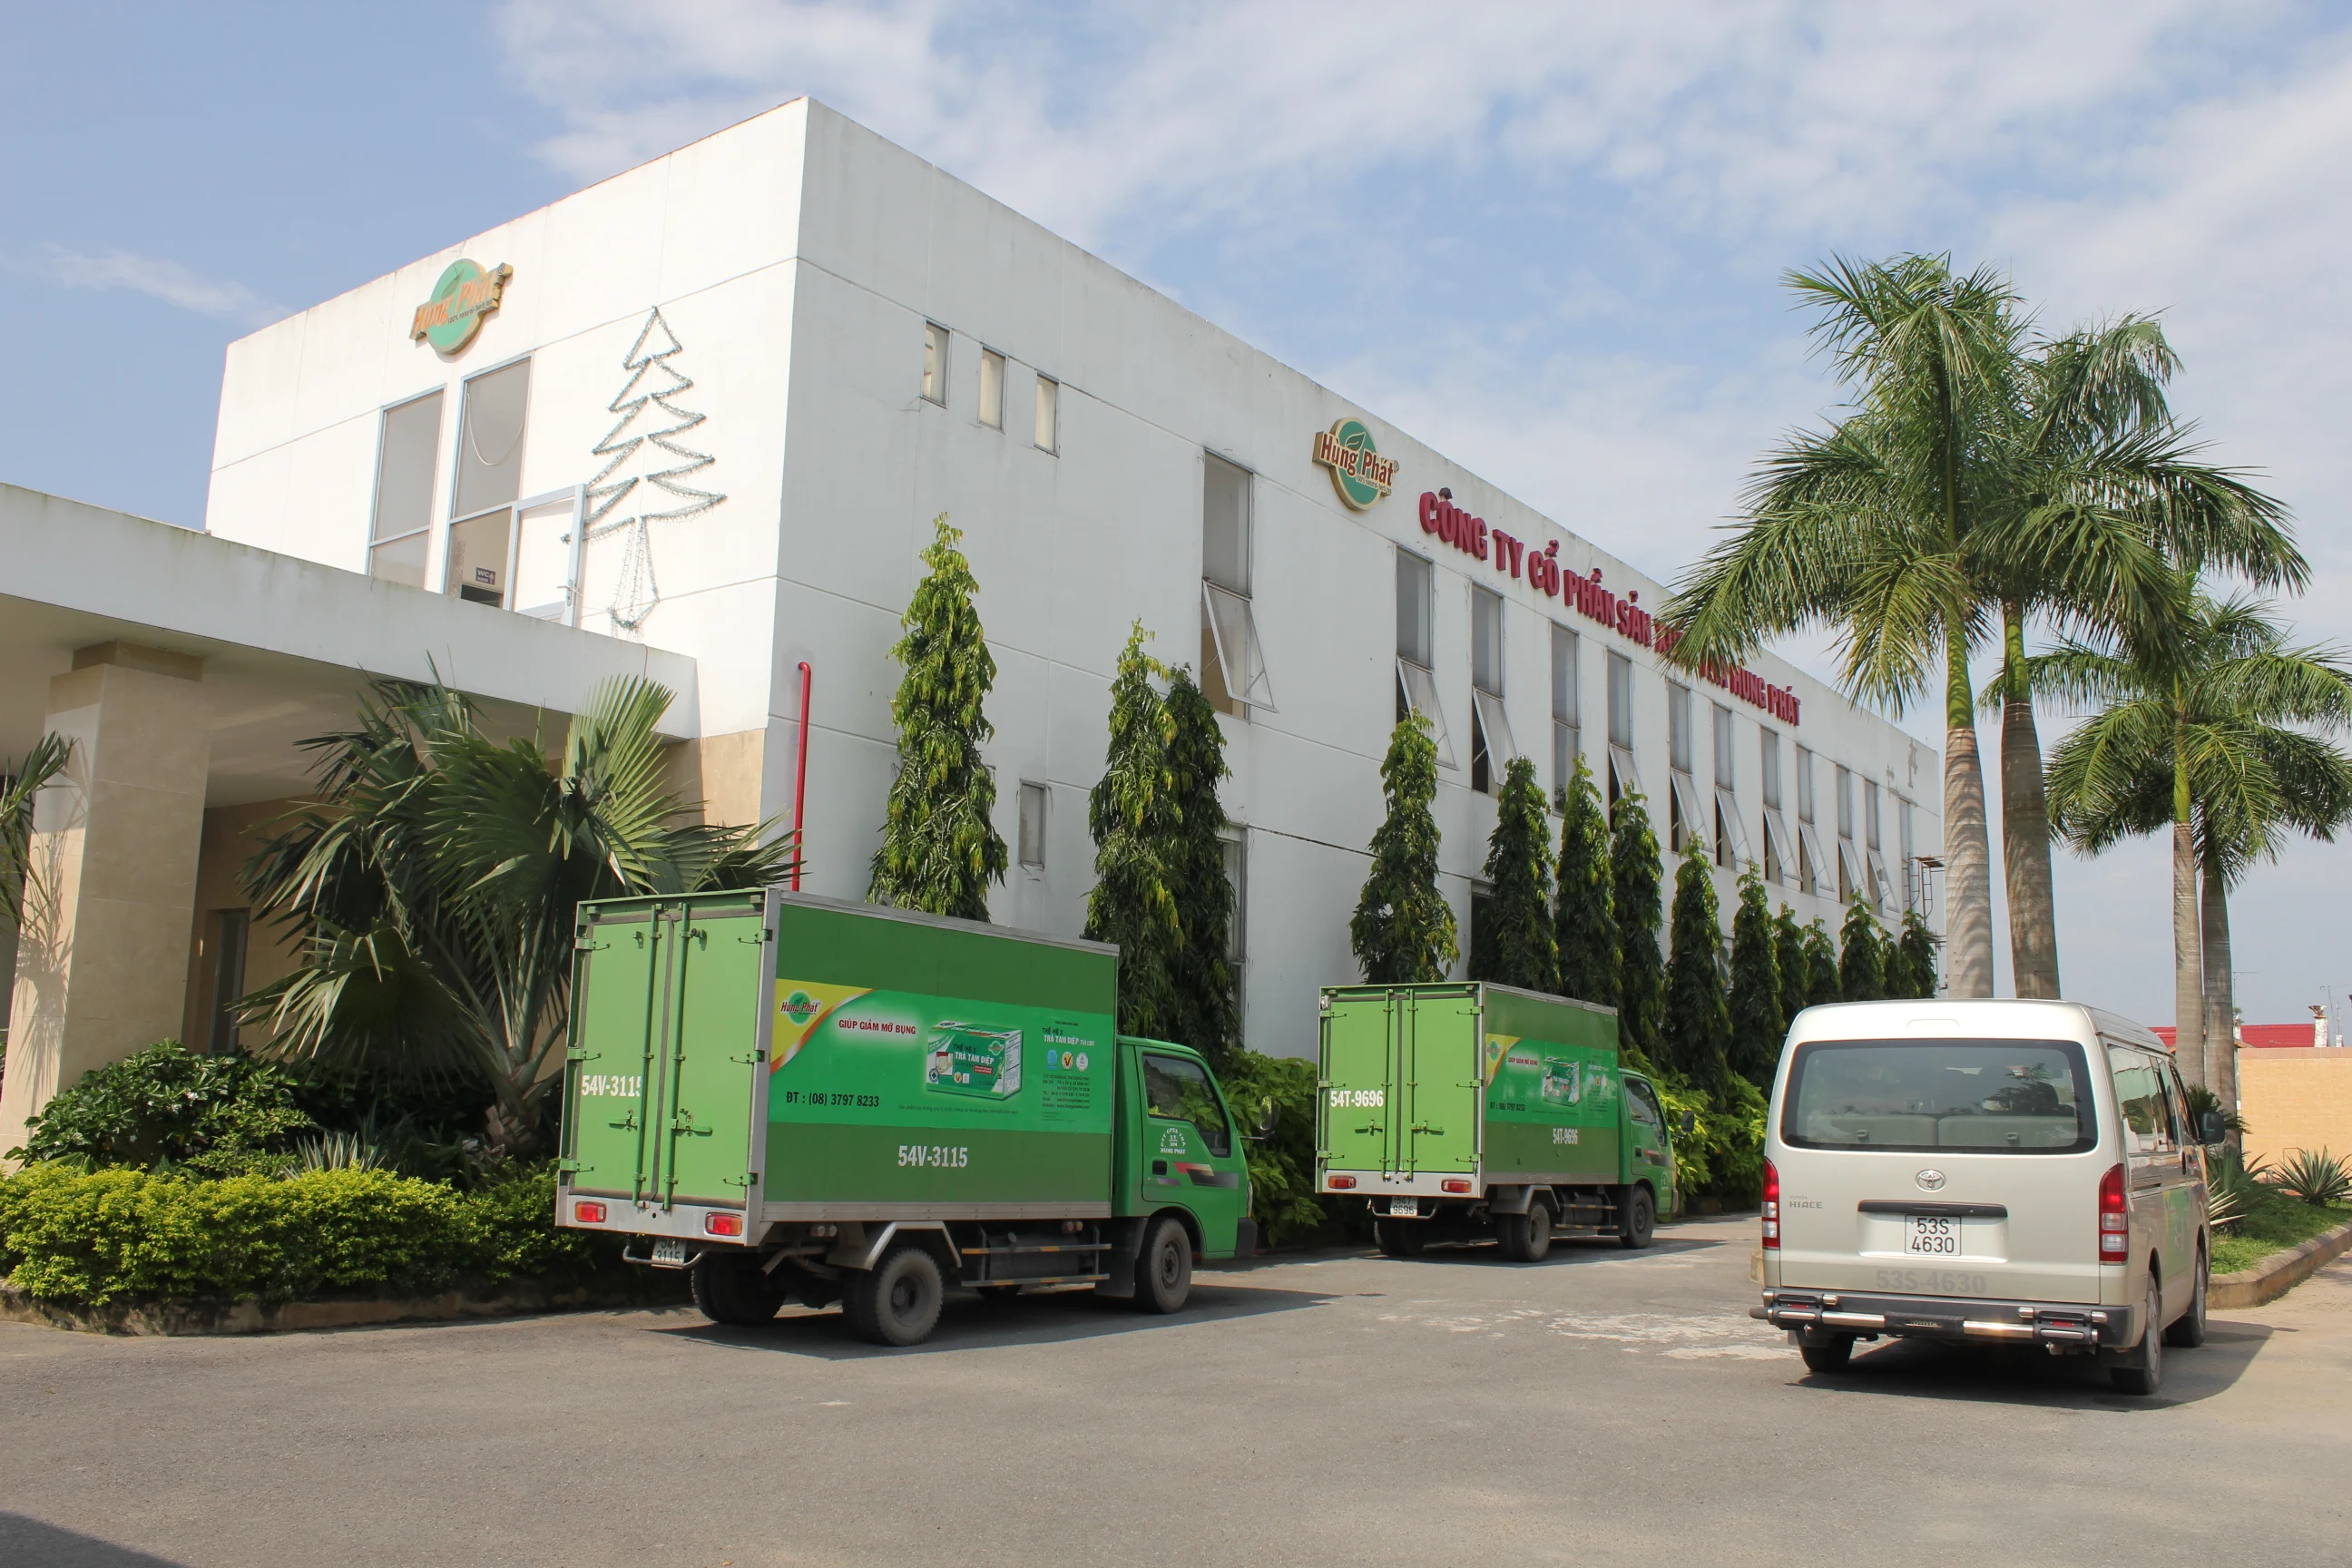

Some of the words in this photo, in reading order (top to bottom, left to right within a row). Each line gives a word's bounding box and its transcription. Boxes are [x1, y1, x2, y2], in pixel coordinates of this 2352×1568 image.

[1320, 434, 1358, 476] Hùng
[1362, 451, 1394, 486] Phát
[477, 569, 489, 578] WC
[1419, 487, 1487, 561] CÔNG
[1493, 529, 1524, 578] TY
[1528, 539, 1560, 597] CỔ
[1563, 568, 1615, 628] PHẦN
[1616, 591, 1651, 647] SẢN
[1767, 685, 1801, 727] PHÁT
[780, 1001, 799, 1014] Hùng
[801, 1001, 818, 1013] Phát
[838, 1018, 858, 1029] GIÚP
[859, 1019, 879, 1031] GIẢM
[895, 1024, 916, 1034] BỤNG
[1044, 1034, 1054, 1043] TRÀ
[1055, 1035, 1067, 1044] TAM
[955, 1051, 966, 1061] TRÀ
[967, 1054, 980, 1063] TAM
[980, 1055, 995, 1065] DIỆP
[786, 1092, 799, 1103] ĐT
[808, 1093, 828, 1106] (08)
[831, 1093, 854, 1106] 3797
[857, 1095, 879, 1107] 8233
[1330, 1090, 1384, 1107] 54T-9696
[898, 1145, 968, 1168] 54V-3115
[1393, 1205, 1414, 1214] 9696
[1789, 1200, 1823, 1209] HIACE
[1916, 1218, 1949, 1235] 53S
[1911, 1235, 1955, 1253] 4630
[1876, 1269, 1987, 1295] 53S-4630
